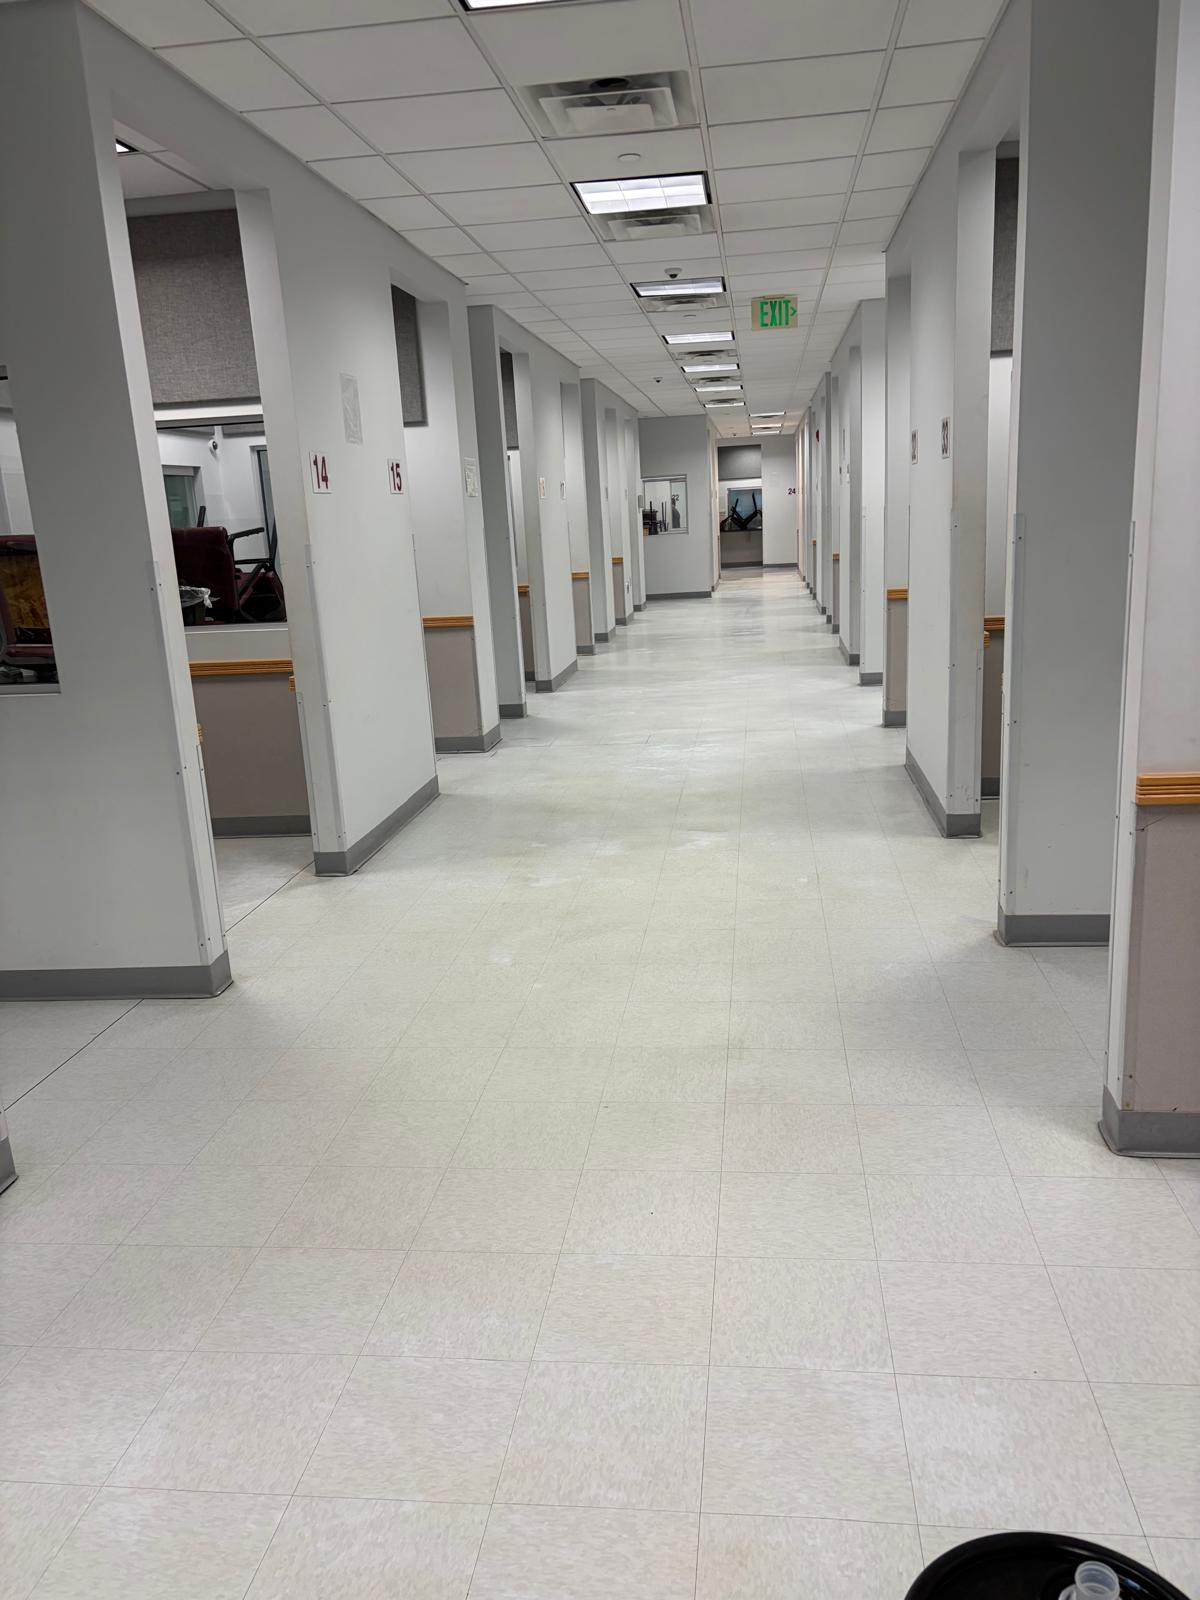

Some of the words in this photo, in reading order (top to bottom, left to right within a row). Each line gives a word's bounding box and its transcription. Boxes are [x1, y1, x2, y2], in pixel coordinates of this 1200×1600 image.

[760, 300, 791, 327] EXIT
[313, 455, 328, 489] 14
[391, 462, 402, 491] 15
